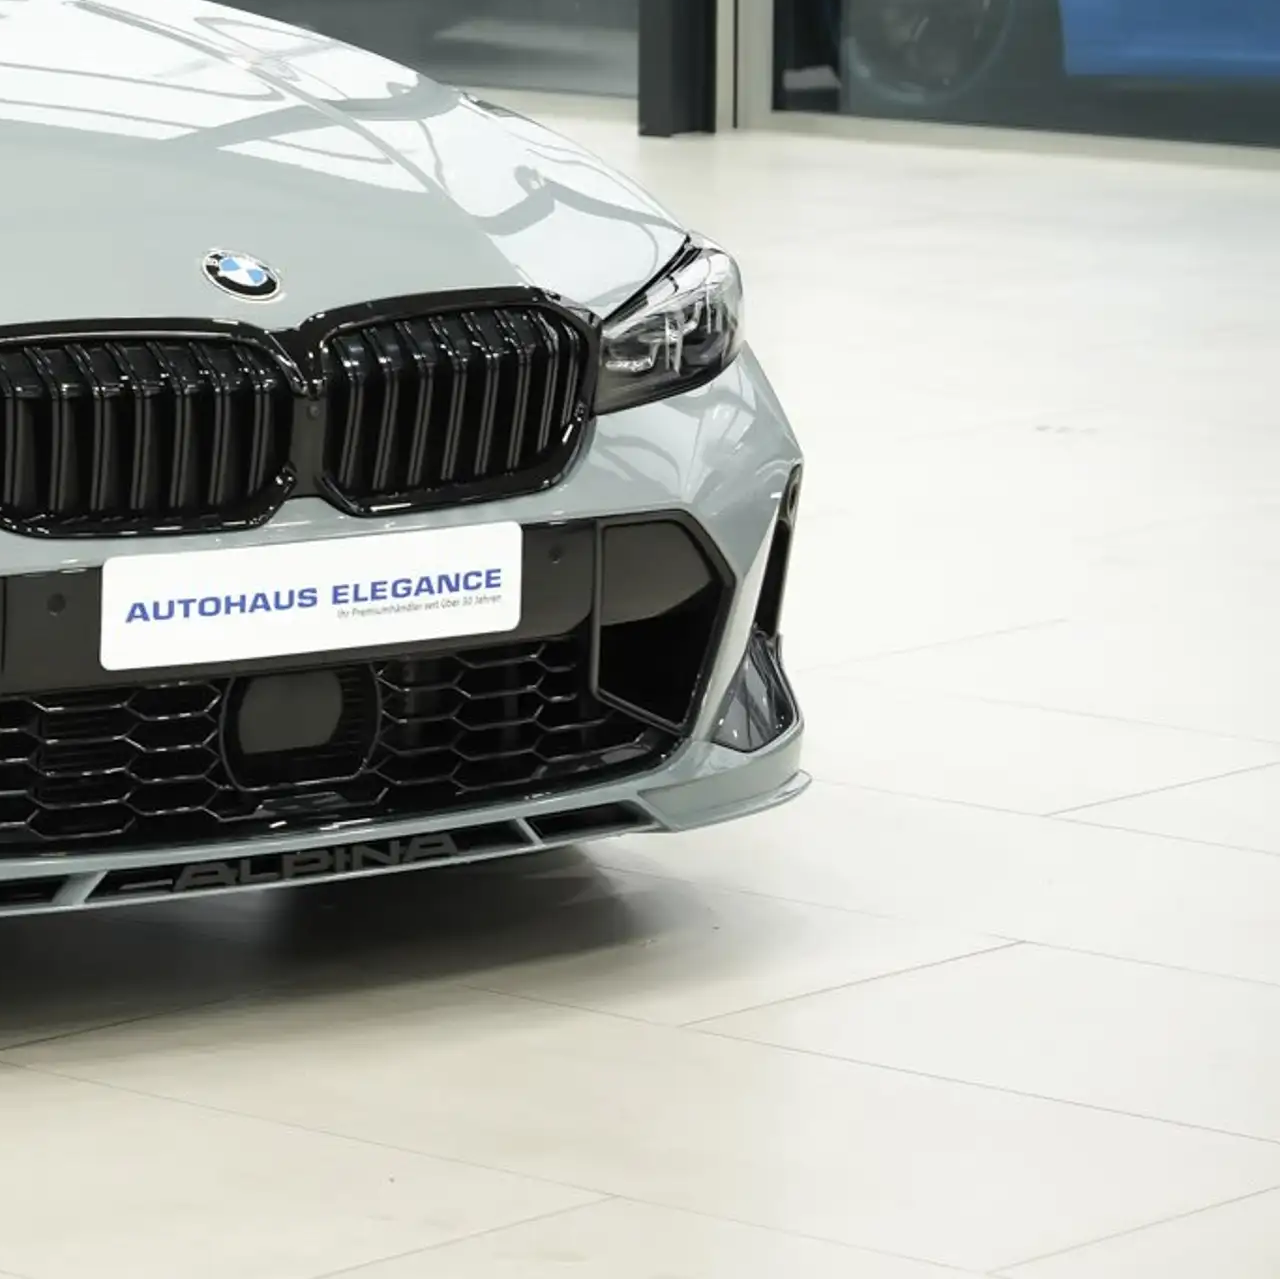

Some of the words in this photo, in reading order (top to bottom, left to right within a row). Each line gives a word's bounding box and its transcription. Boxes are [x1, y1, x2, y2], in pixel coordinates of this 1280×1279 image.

[125, 587, 319, 624] AUTOHAUS
[331, 569, 503, 606] ELEGANCE
[171, 833, 460, 893] ALPINA
